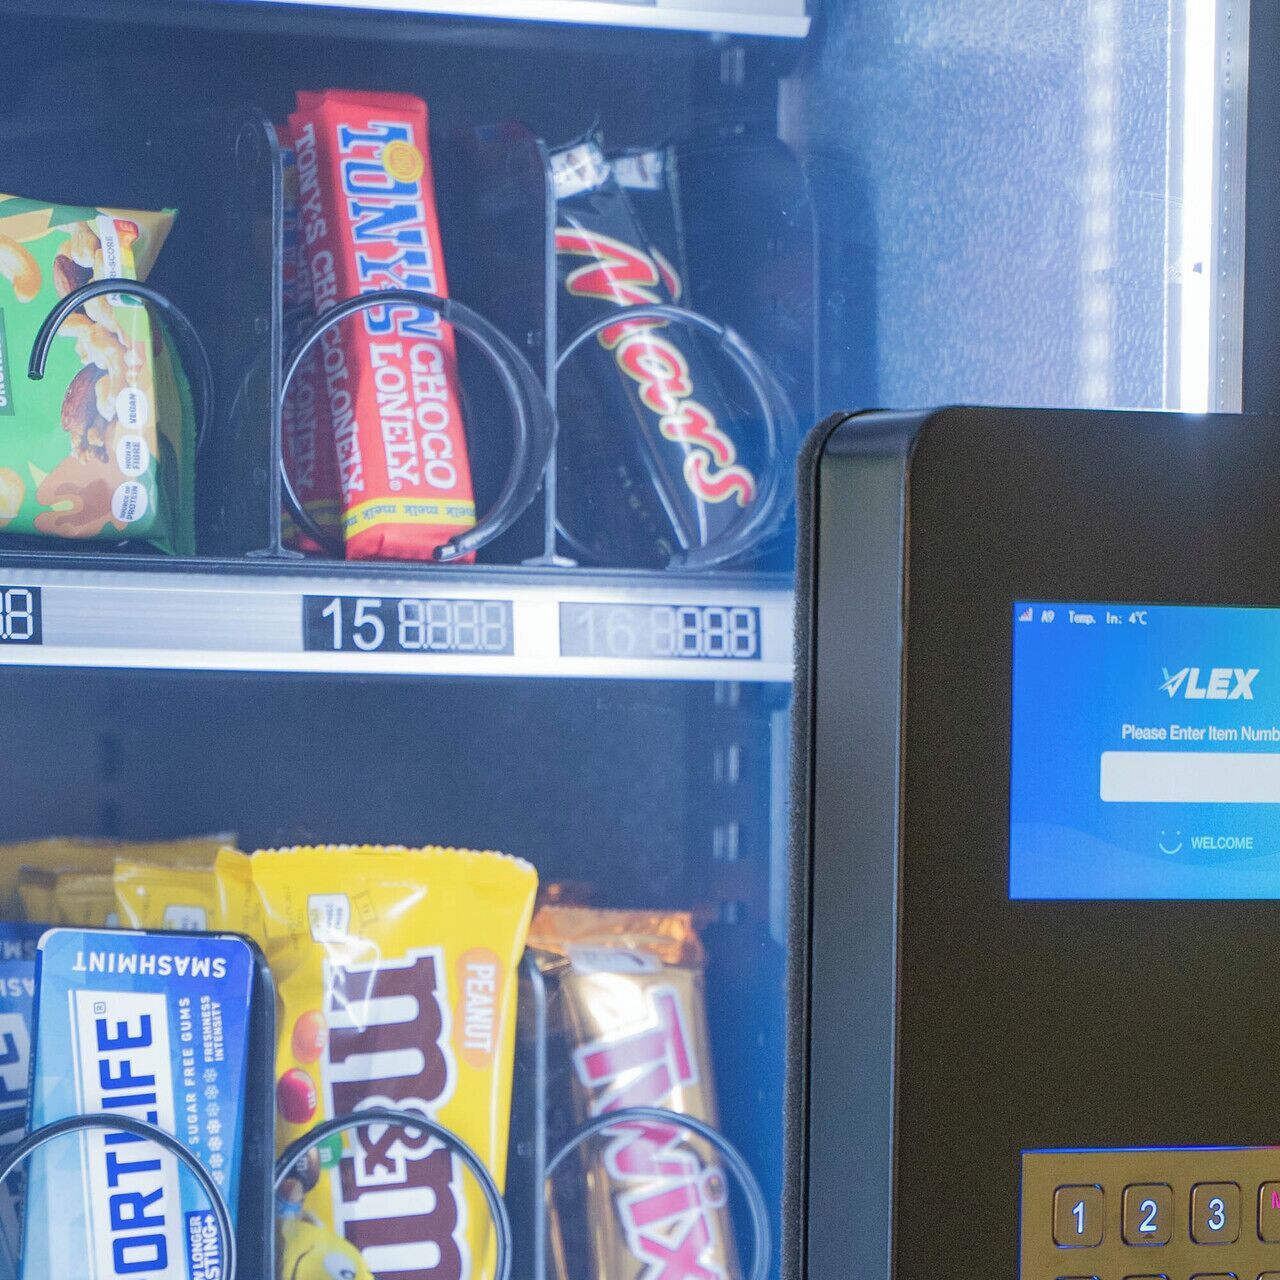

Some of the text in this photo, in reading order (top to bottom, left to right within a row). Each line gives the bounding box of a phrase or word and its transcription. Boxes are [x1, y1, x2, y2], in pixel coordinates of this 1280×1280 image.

[106, 236, 118, 302] NRI-SCORE
[128, 393, 137, 424] VEGAN
[370, 343, 421, 491] LONELY
[409, 343, 457, 490] CHOCO
[126, 485, 138, 520] PROTEIN
[362, 504, 397, 520] melk
[403, 505, 439, 517] melk
[321, 597, 386, 651] 15
[577, 607, 636, 656] 16
[1069, 609, 1097, 625] Temp.
[1106, 611, 1123, 624] In:
[1122, 724, 1167, 741] Please
[1170, 725, 1206, 741] Enter
[1209, 726, 1238, 741] Item
[1191, 836, 1254, 850] WELCOME
[71, 950, 227, 979] SMASHMINT
[463, 963, 496, 1054] PEANUT
[200, 996, 213, 1063] FRESHNESS
[212, 1002, 225, 1062] INTENSITY
[178, 997, 200, 1145] SUGAR FREE GUMS
[1071, 1201, 1085, 1234] 1
[1138, 1199, 1158, 1233] 2
[1208, 1197, 1226, 1231] 3
[189, 1215, 204, 1269] LONGER
